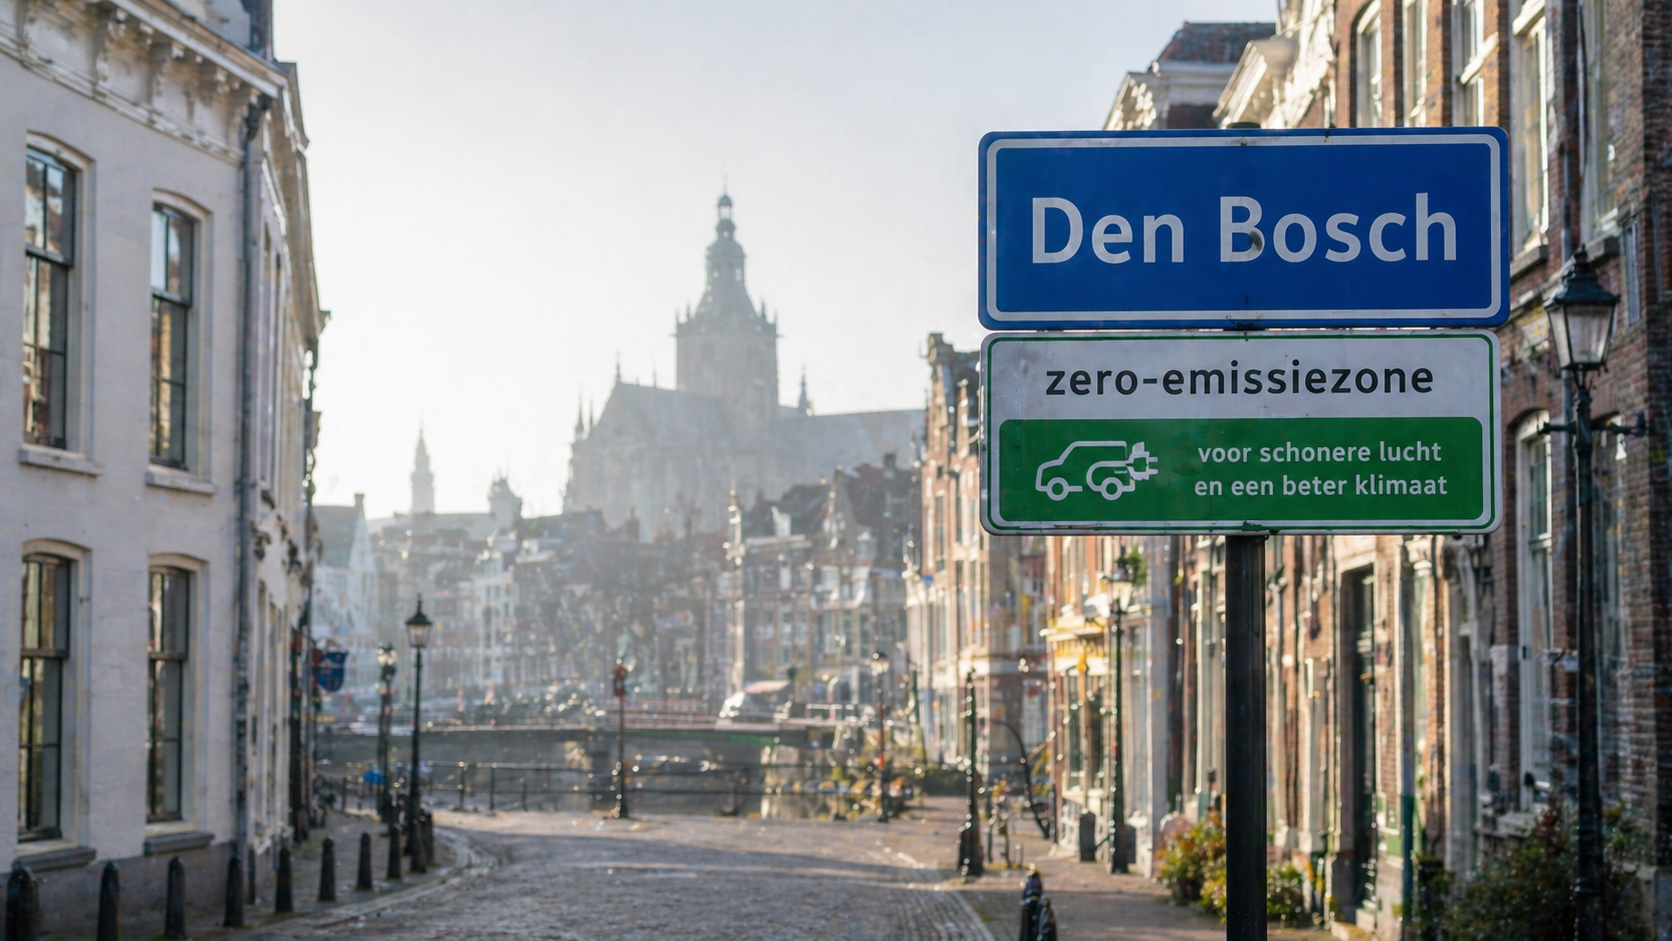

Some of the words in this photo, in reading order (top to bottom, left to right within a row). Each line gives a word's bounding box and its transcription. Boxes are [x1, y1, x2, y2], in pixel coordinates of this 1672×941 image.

[1032, 197, 1184, 264] Den
[1220, 192, 1457, 263] Bosch
[1046, 359, 1434, 395] zero-emissiezone
[1198, 447, 1252, 463] voor
[1260, 441, 1371, 463] schonere
[1380, 440, 1442, 462] lucht
[1194, 480, 1222, 496] en
[1231, 480, 1274, 496] een
[1283, 474, 1348, 496] beter
[1355, 473, 1448, 495] klimaat
